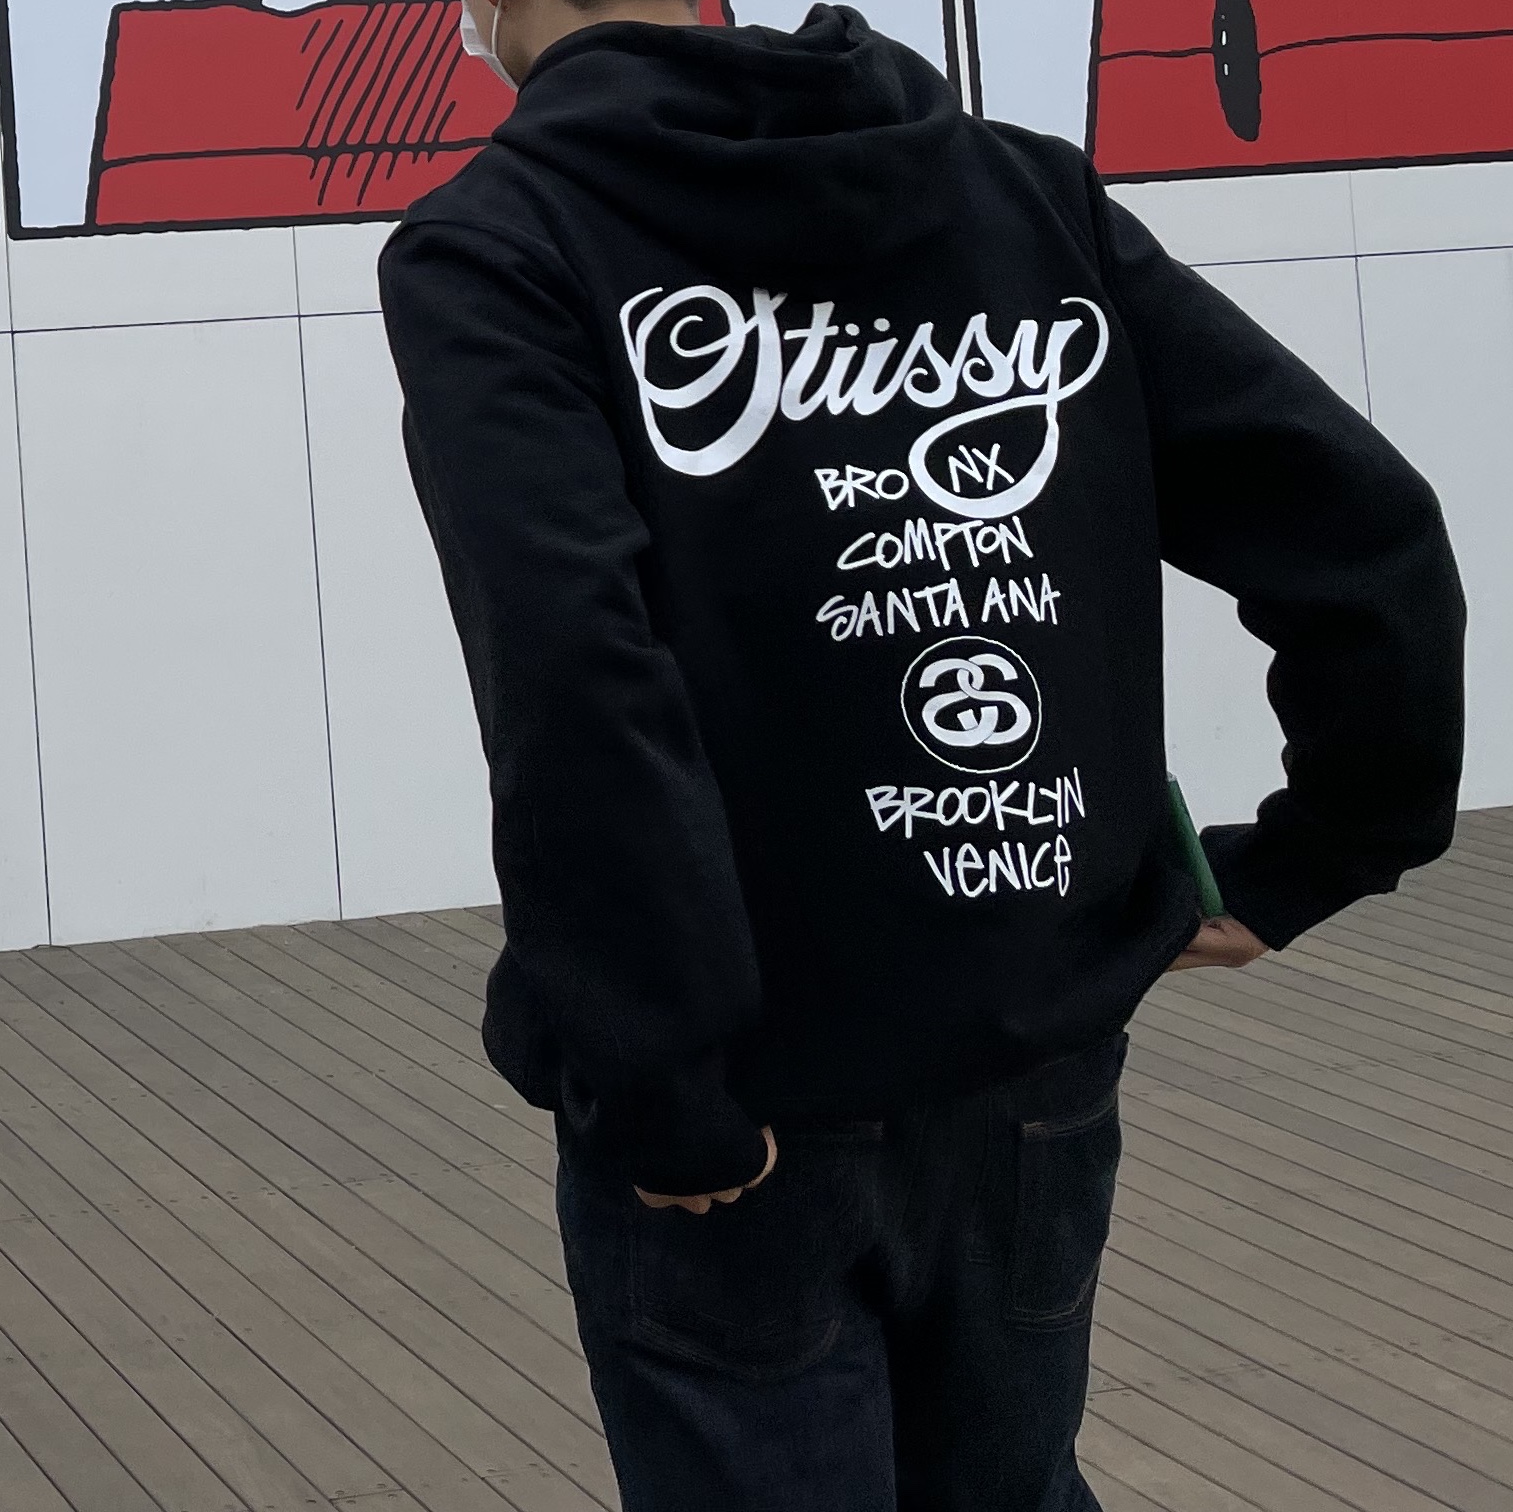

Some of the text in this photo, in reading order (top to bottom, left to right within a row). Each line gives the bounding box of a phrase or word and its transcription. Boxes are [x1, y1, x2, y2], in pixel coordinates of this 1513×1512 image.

[837, 516, 1034, 571] COMPTON
[815, 572, 1062, 642] SANTA ANA
[864, 766, 1086, 839] BROOKLYN
